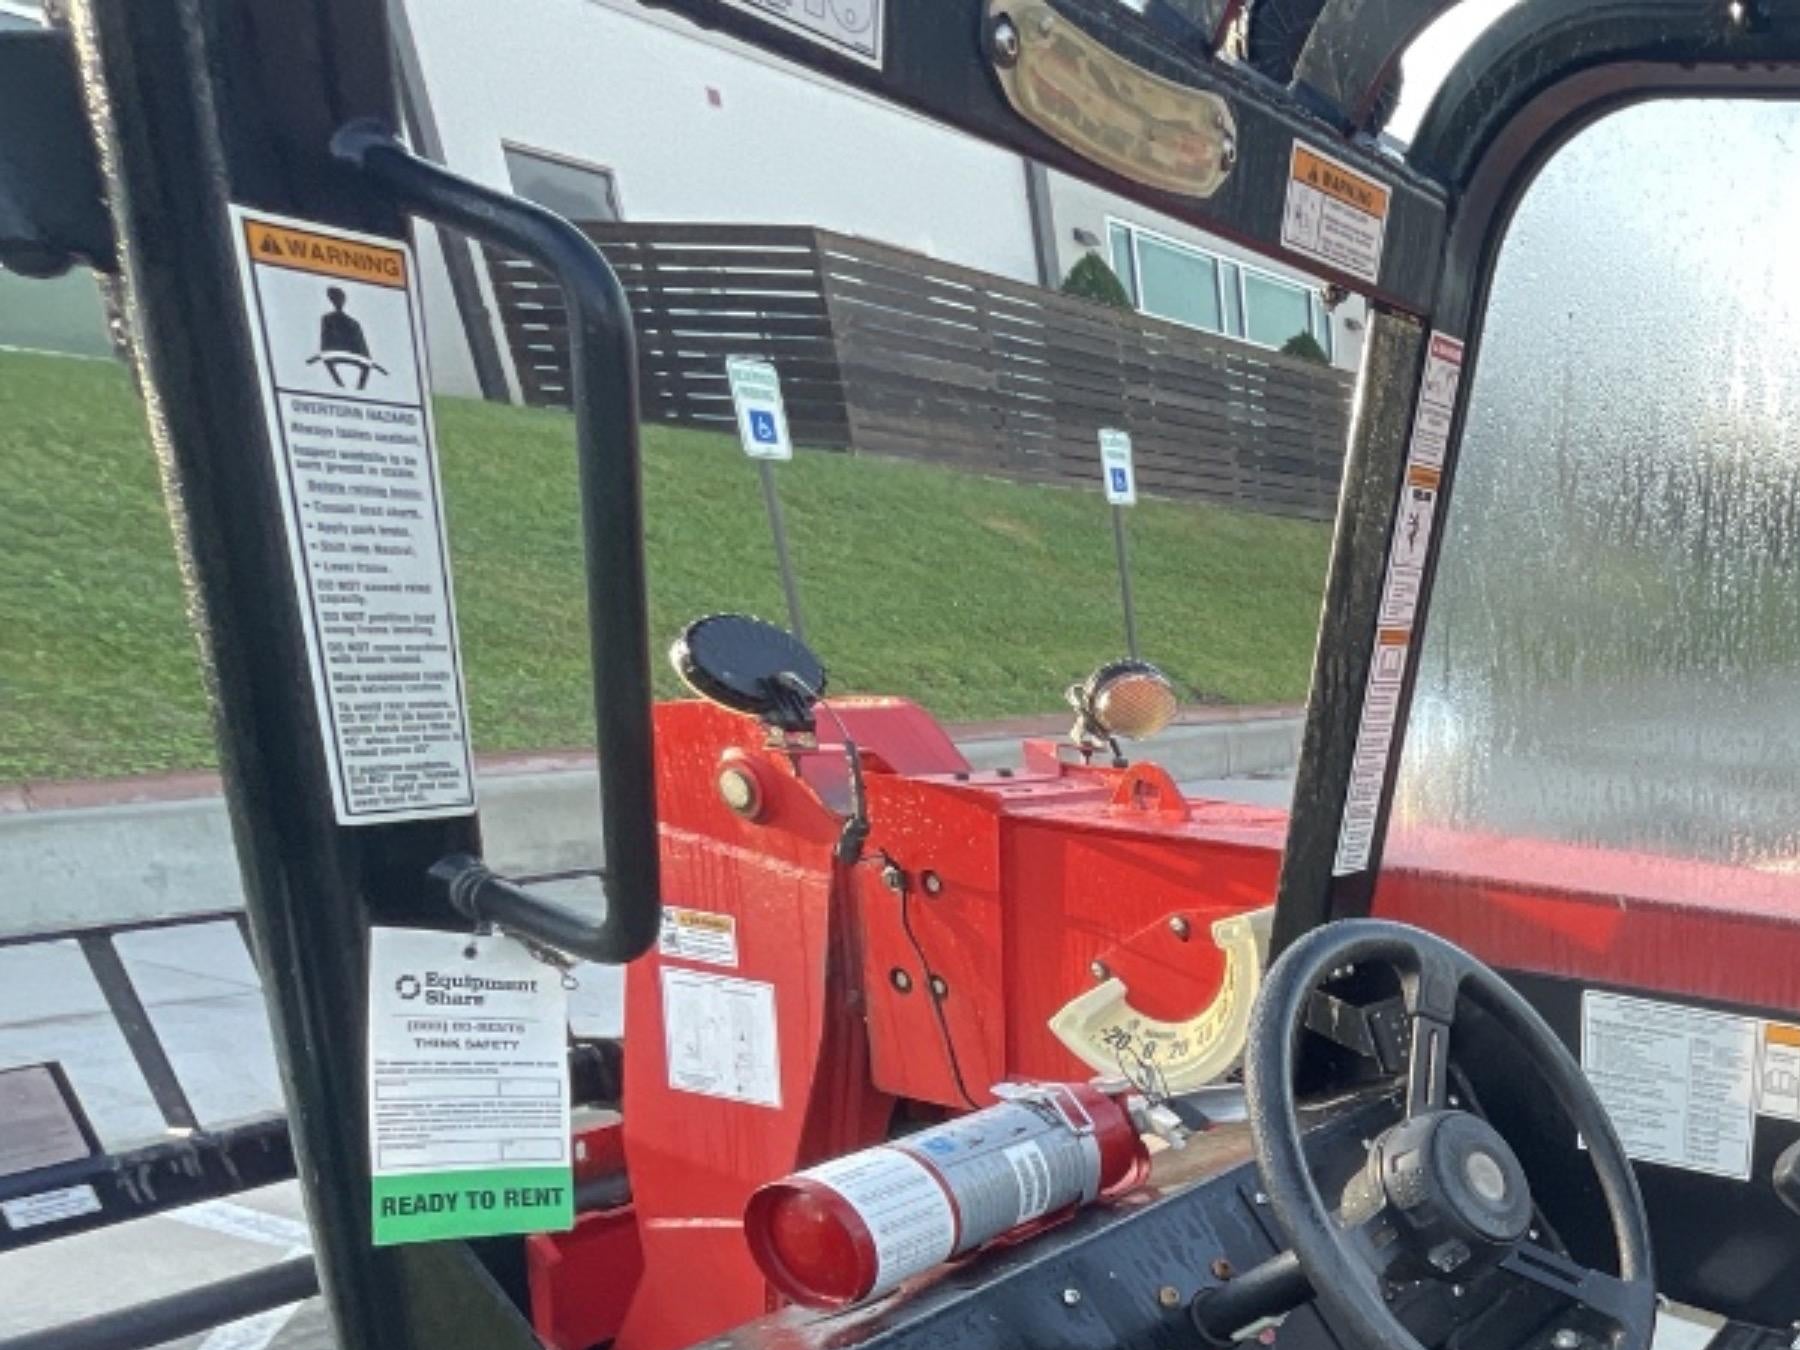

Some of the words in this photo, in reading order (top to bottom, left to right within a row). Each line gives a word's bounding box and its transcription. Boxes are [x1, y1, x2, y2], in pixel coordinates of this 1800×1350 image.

[285, 236, 399, 277] WARNING
[426, 972, 537, 992] Equipment
[426, 990, 484, 1006] Share
[414, 1038, 460, 1050] THINK
[465, 1038, 520, 1050] SAFETY
[381, 1191, 460, 1217] READY
[465, 1191, 496, 1211] TO
[504, 1187, 564, 1209] RENT
